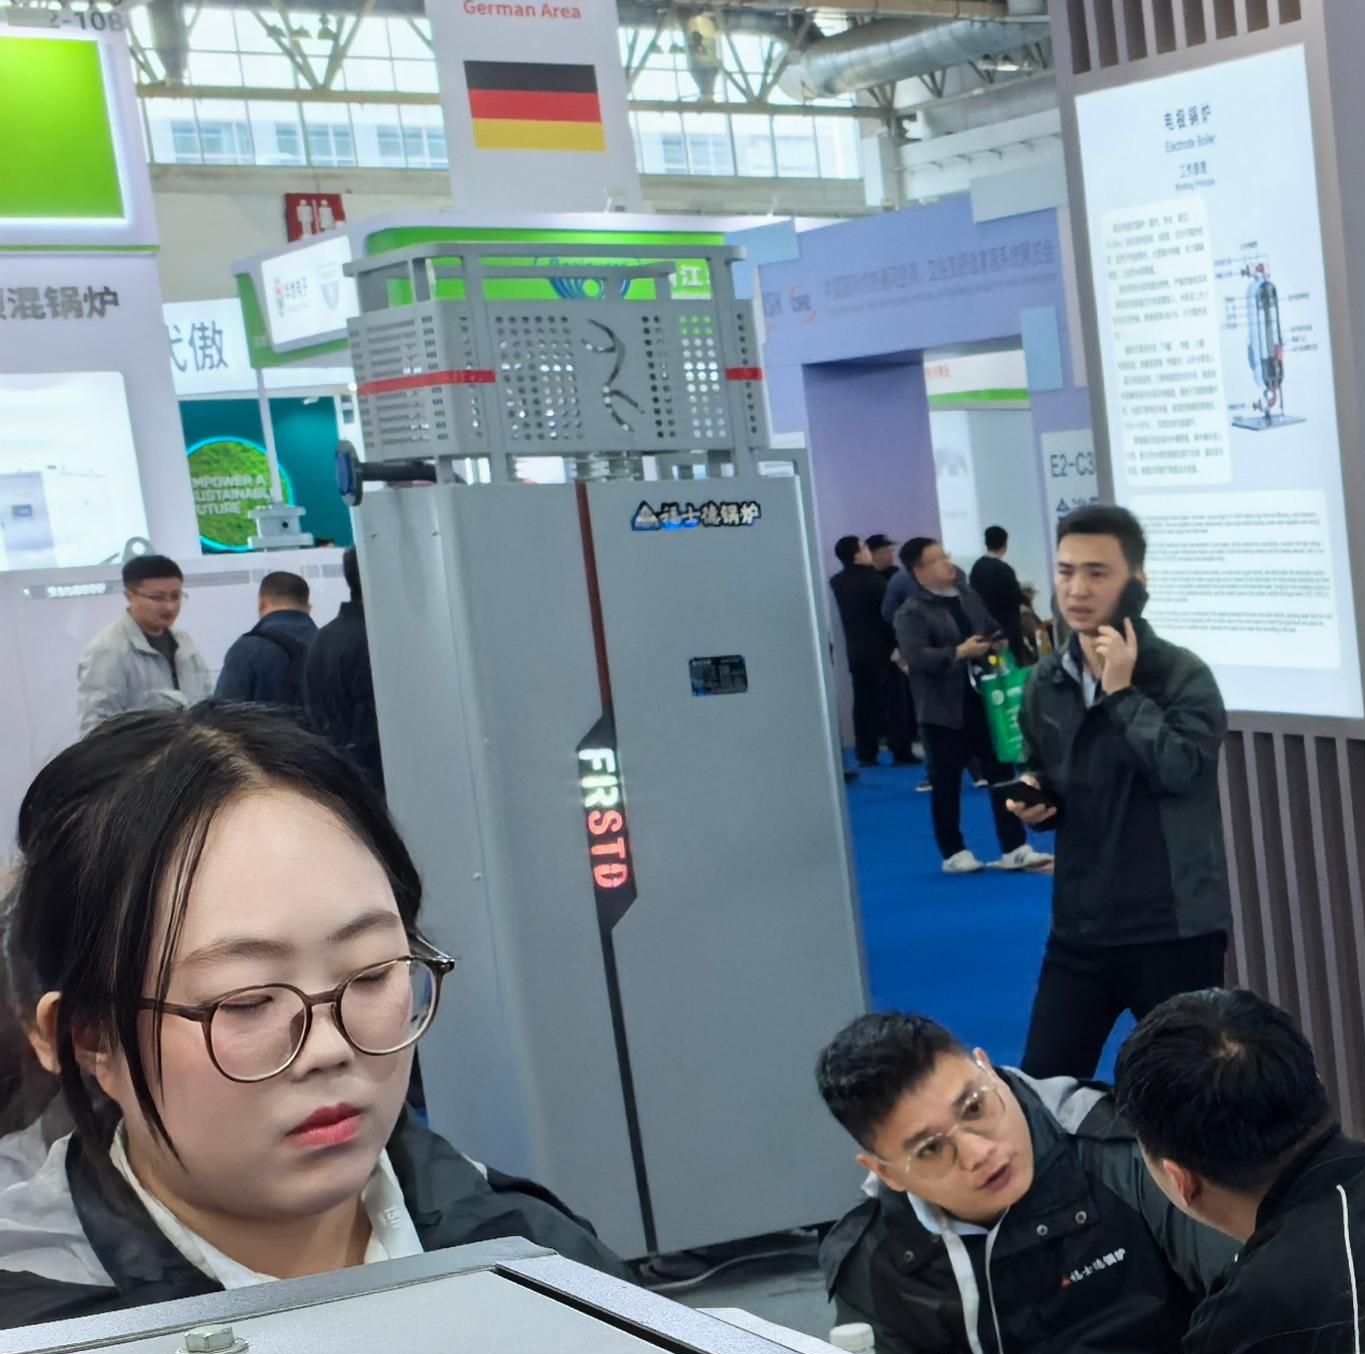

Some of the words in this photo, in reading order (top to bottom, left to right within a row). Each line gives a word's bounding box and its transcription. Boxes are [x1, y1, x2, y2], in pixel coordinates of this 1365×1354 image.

[463, 0, 537, 17] German
[541, 3, 582, 20] Area
[0, 285, 120, 320] 混锅炉
[578, 747, 629, 889] FIRSTD
